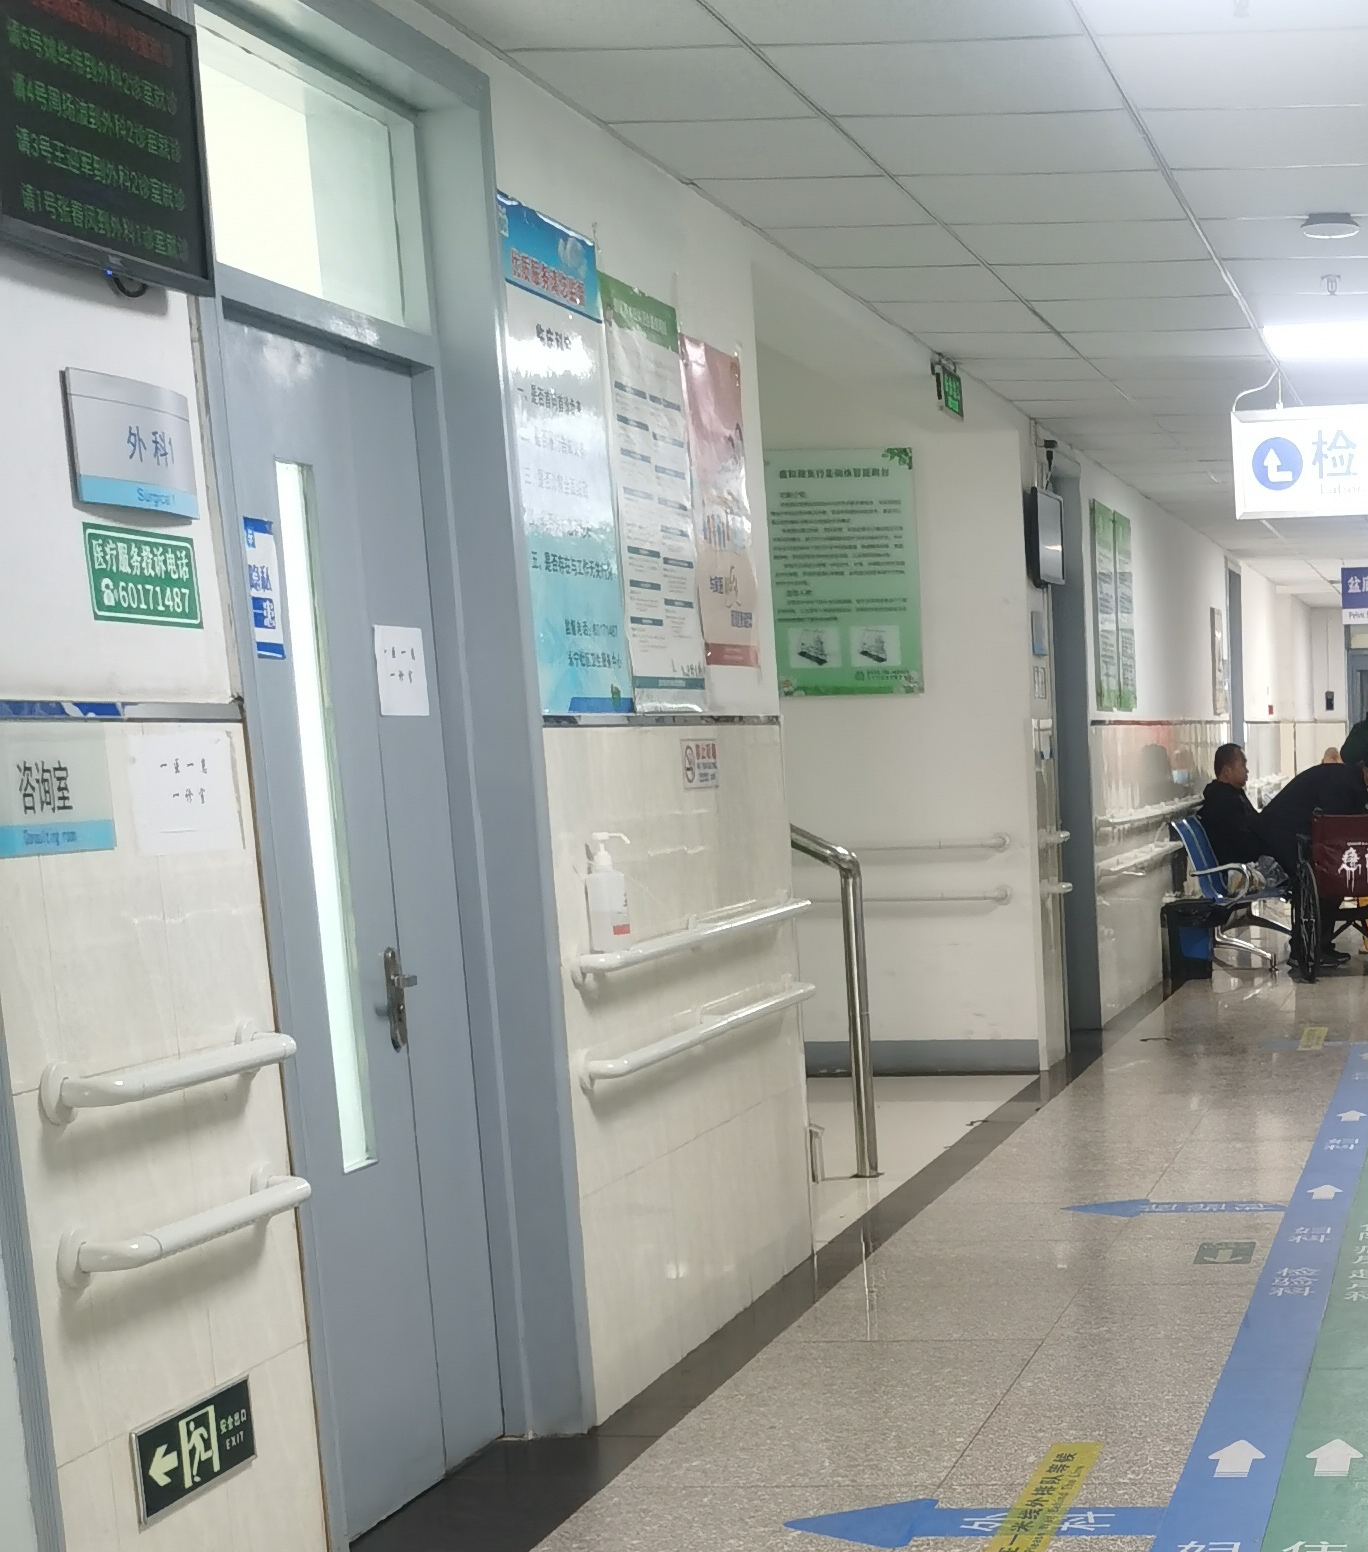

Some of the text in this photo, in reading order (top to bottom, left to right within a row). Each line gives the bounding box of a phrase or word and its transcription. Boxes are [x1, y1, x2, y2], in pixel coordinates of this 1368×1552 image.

[91, 539, 189, 582] 医疗服务投诉电话
[118, 582, 190, 613] 60171487
[16, 760, 74, 815] 咨询室
[219, 1408, 247, 1435] 安全出口
[225, 1430, 245, 1451] EXIT
